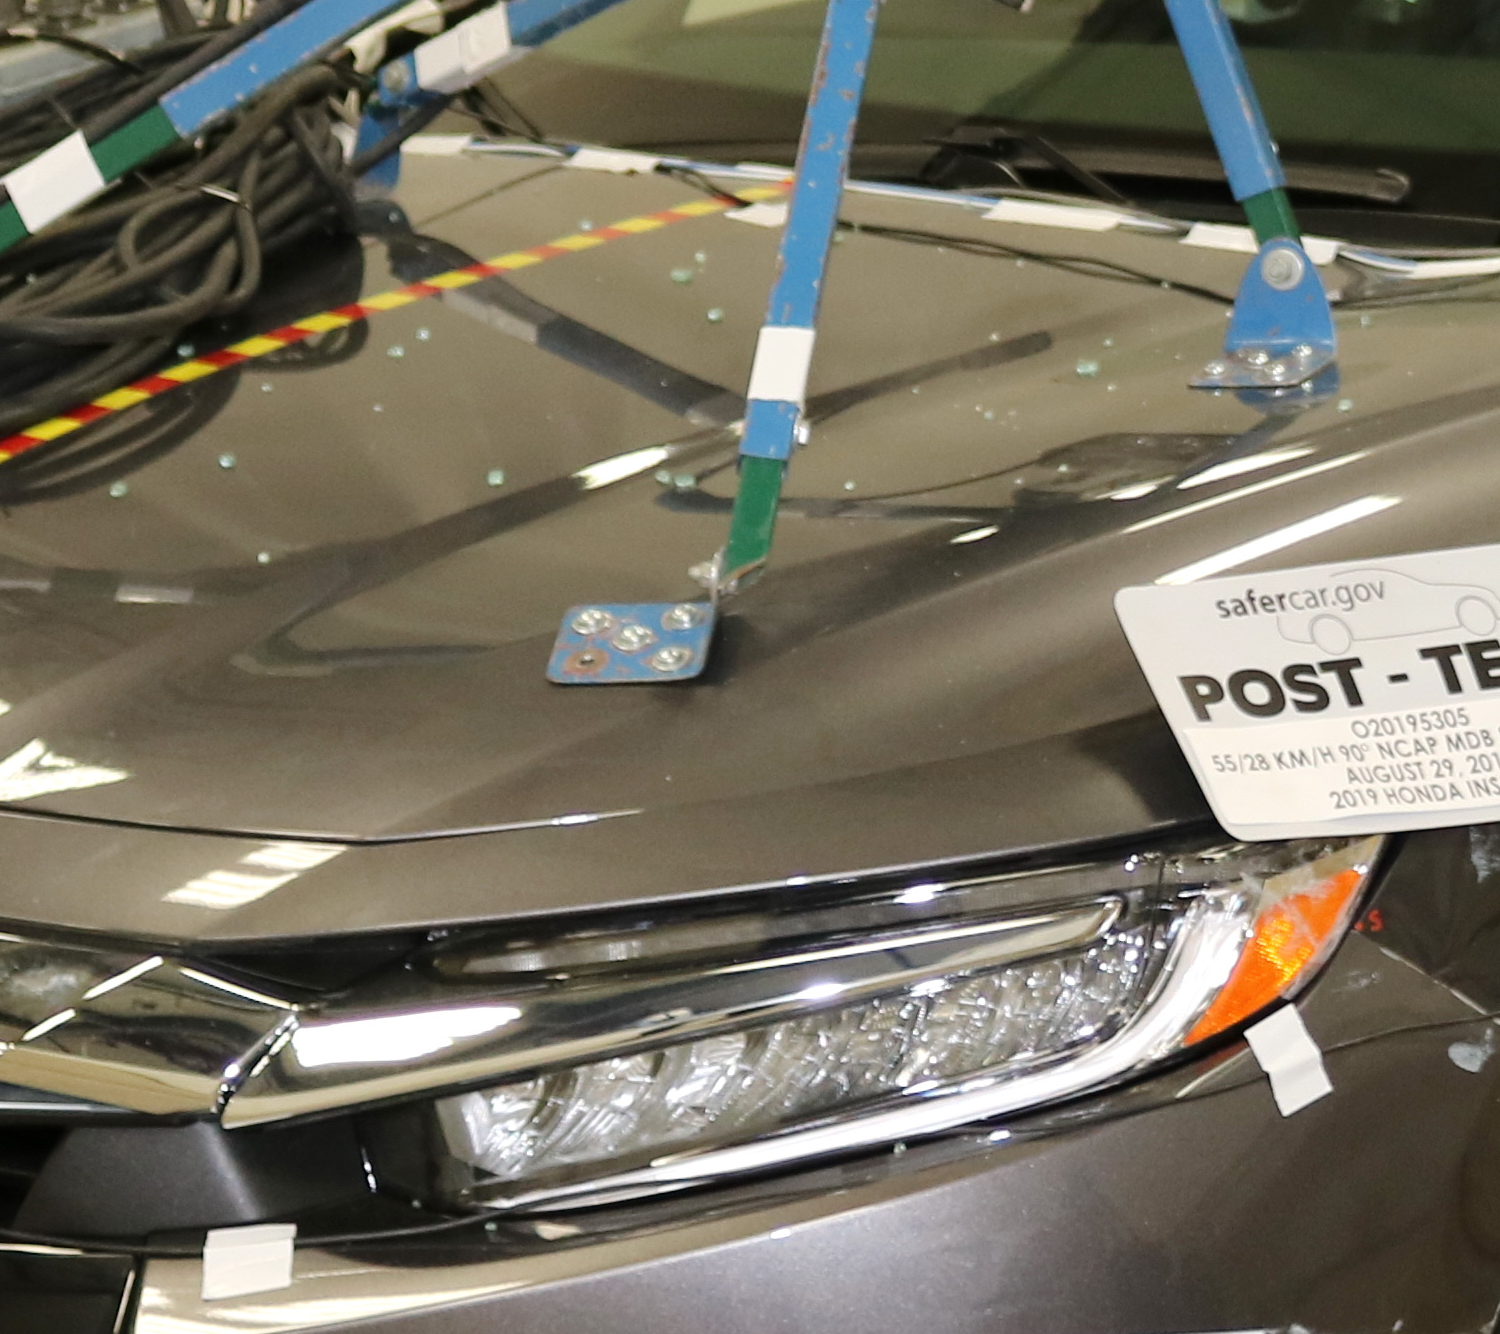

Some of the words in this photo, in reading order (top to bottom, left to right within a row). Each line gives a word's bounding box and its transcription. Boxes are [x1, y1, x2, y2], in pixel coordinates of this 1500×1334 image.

[1215, 580, 1386, 619] safercar.gov
[1178, 657, 1363, 722] POST
[1211, 753, 1271, 774] 55/28
[1273, 745, 1335, 769] KM/H
[1338, 743, 1369, 763] 90°
[1376, 736, 1438, 760] NCAP
[1445, 729, 1495, 753] MDB
[1347, 761, 1426, 785] AUGUST
[1329, 789, 1378, 809] 2019
[1385, 782, 1464, 805] HONDA
